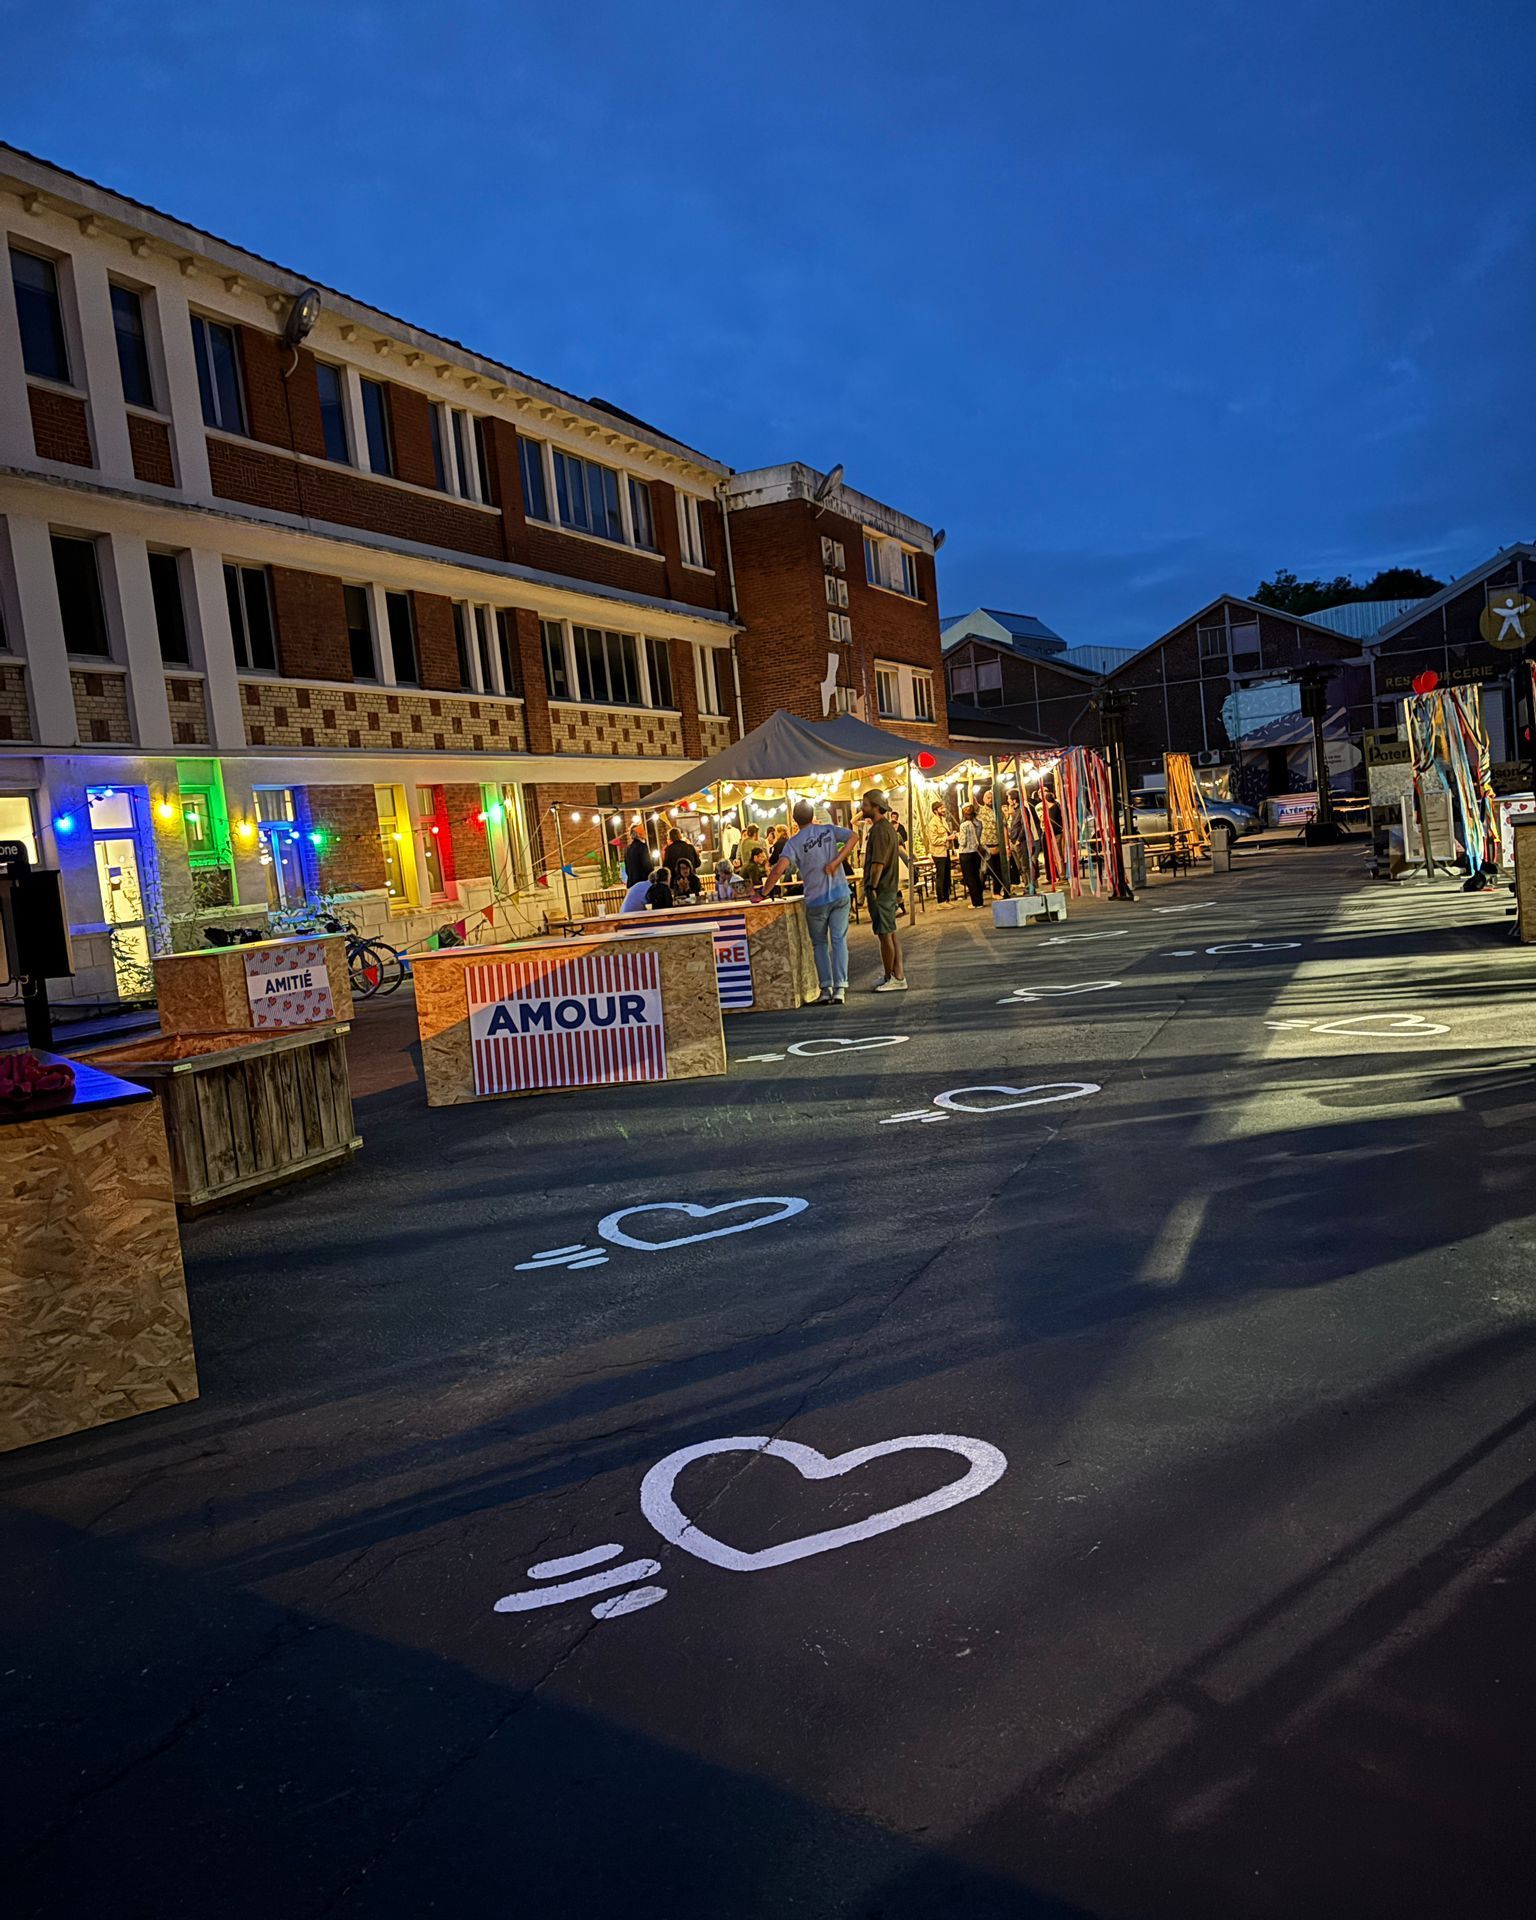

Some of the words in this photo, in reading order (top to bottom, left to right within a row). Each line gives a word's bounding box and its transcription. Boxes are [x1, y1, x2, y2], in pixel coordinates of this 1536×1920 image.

[1385, 665, 1494, 688] RESURCERIE
[1369, 746, 1411, 763] Poter
[715, 946, 746, 963] RE
[265, 969, 313, 994] AMITIÉ
[486, 994, 647, 1036] AMOUR
